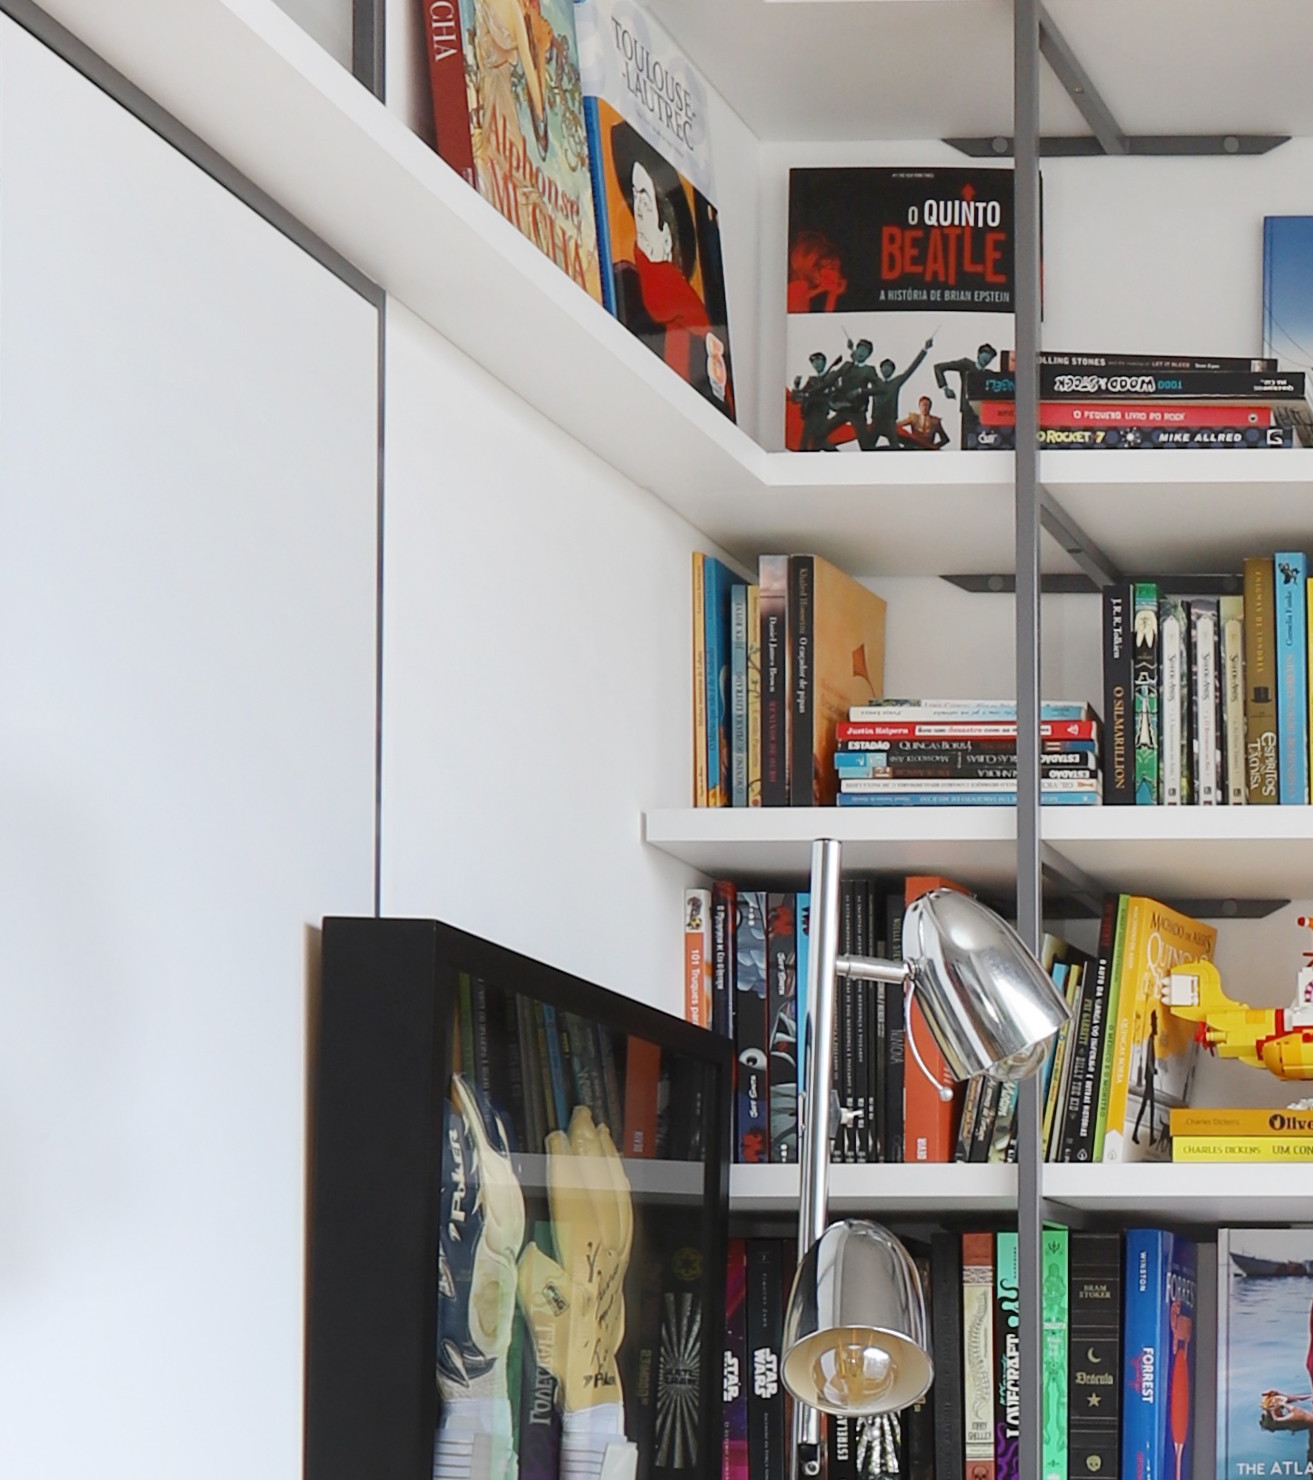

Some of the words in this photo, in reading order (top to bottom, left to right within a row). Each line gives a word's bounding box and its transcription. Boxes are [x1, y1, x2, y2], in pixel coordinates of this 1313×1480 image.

[610, 17, 696, 119] TOULOUSE-
[924, 200, 1001, 227] QUINTO
[881, 226, 1006, 285] BEATLE
[1114, 687, 1124, 697] O
[1114, 700, 1125, 788] SILMARILLION
[1272, 1146, 1291, 1156] UM
[753, 1348, 767, 1398] WARS
[766, 1348, 778, 1398] STAR
[1142, 1347, 1155, 1404] FORREST
[1237, 1462, 1265, 1475] THE
